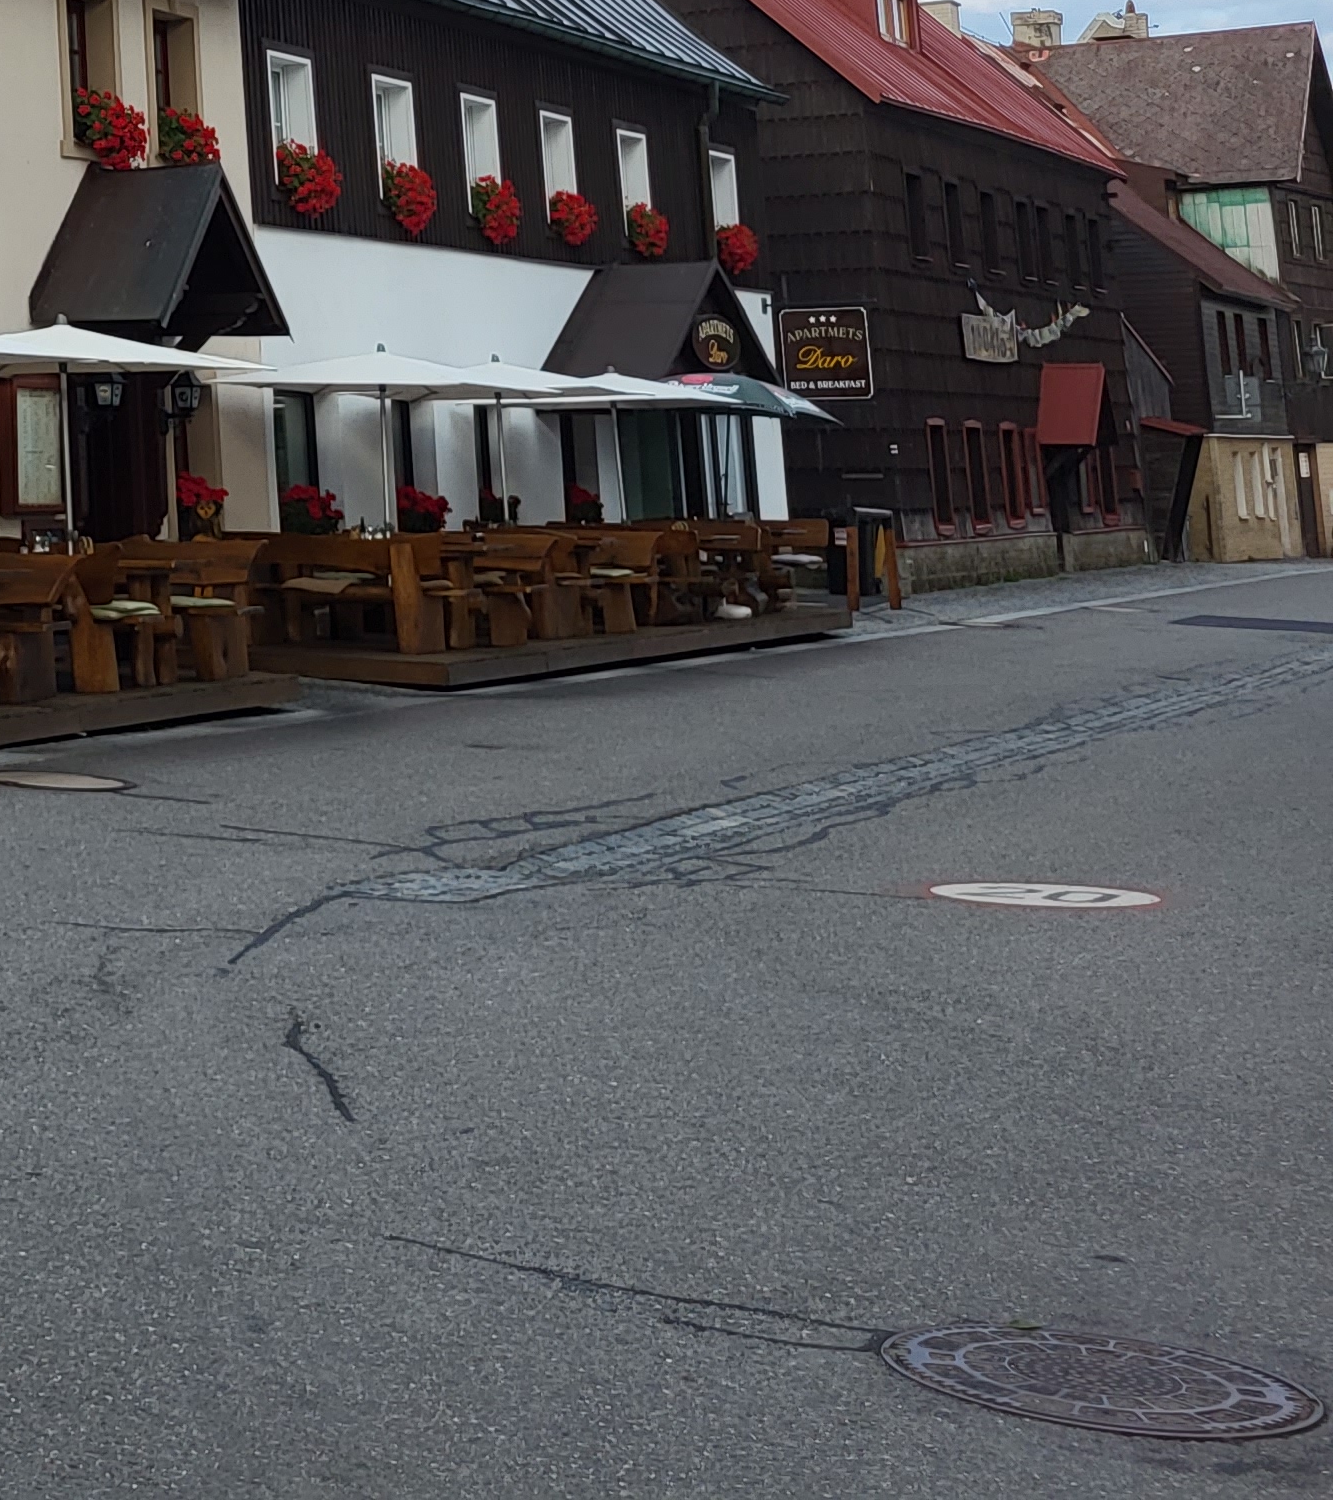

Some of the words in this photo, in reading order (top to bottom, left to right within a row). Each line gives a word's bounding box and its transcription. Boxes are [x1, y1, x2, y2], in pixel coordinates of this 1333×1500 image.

[787, 326, 863, 343] APARTMETS
[796, 345, 858, 369] Daro
[790, 381, 807, 389] BED
[808, 381, 816, 389] &
[817, 379, 866, 389] BREAKFAST
[955, 886, 1121, 903] 20
